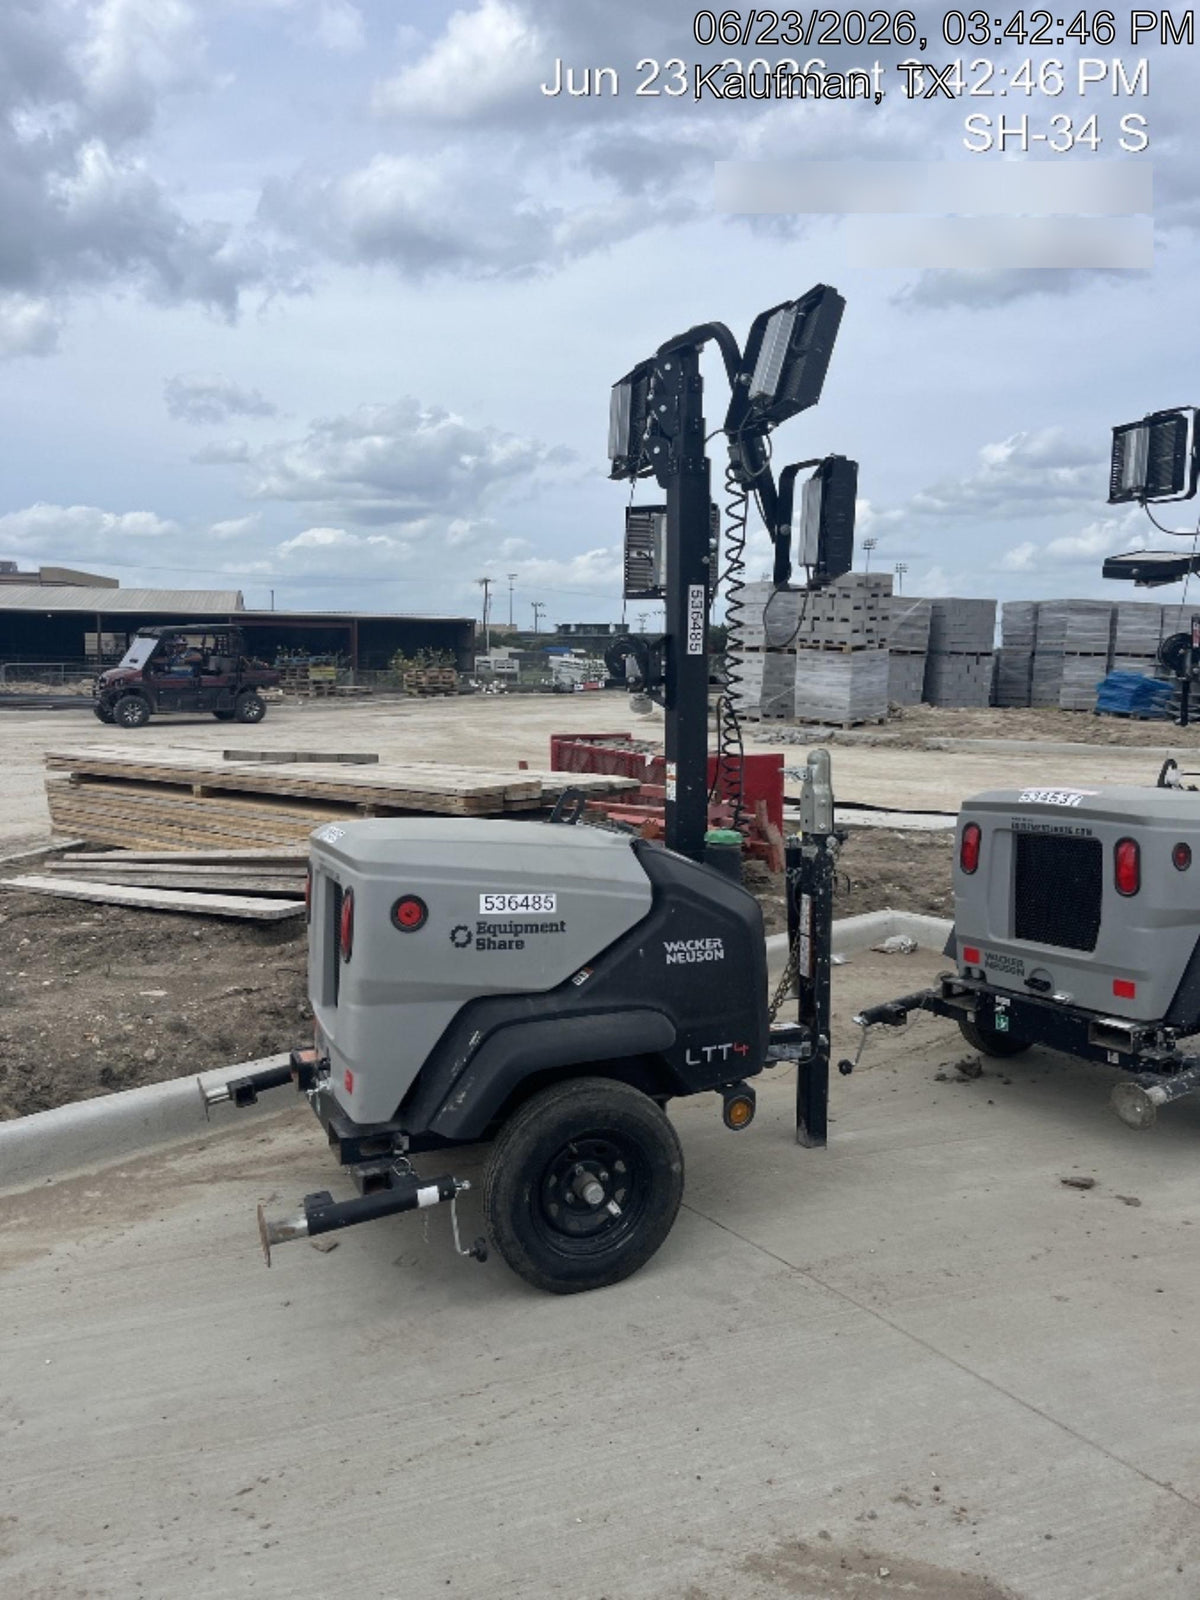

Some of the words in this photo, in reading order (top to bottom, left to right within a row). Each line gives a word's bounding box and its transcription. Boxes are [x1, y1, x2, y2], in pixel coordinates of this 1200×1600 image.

[689, 589, 703, 652] 536485
[484, 895, 554, 911] 536485
[476, 920, 567, 937] Equipment
[476, 937, 526, 951] Share
[662, 938, 723, 953] WACKER
[665, 949, 725, 965] NEUSON
[685, 1042, 750, 1066] LTT4
